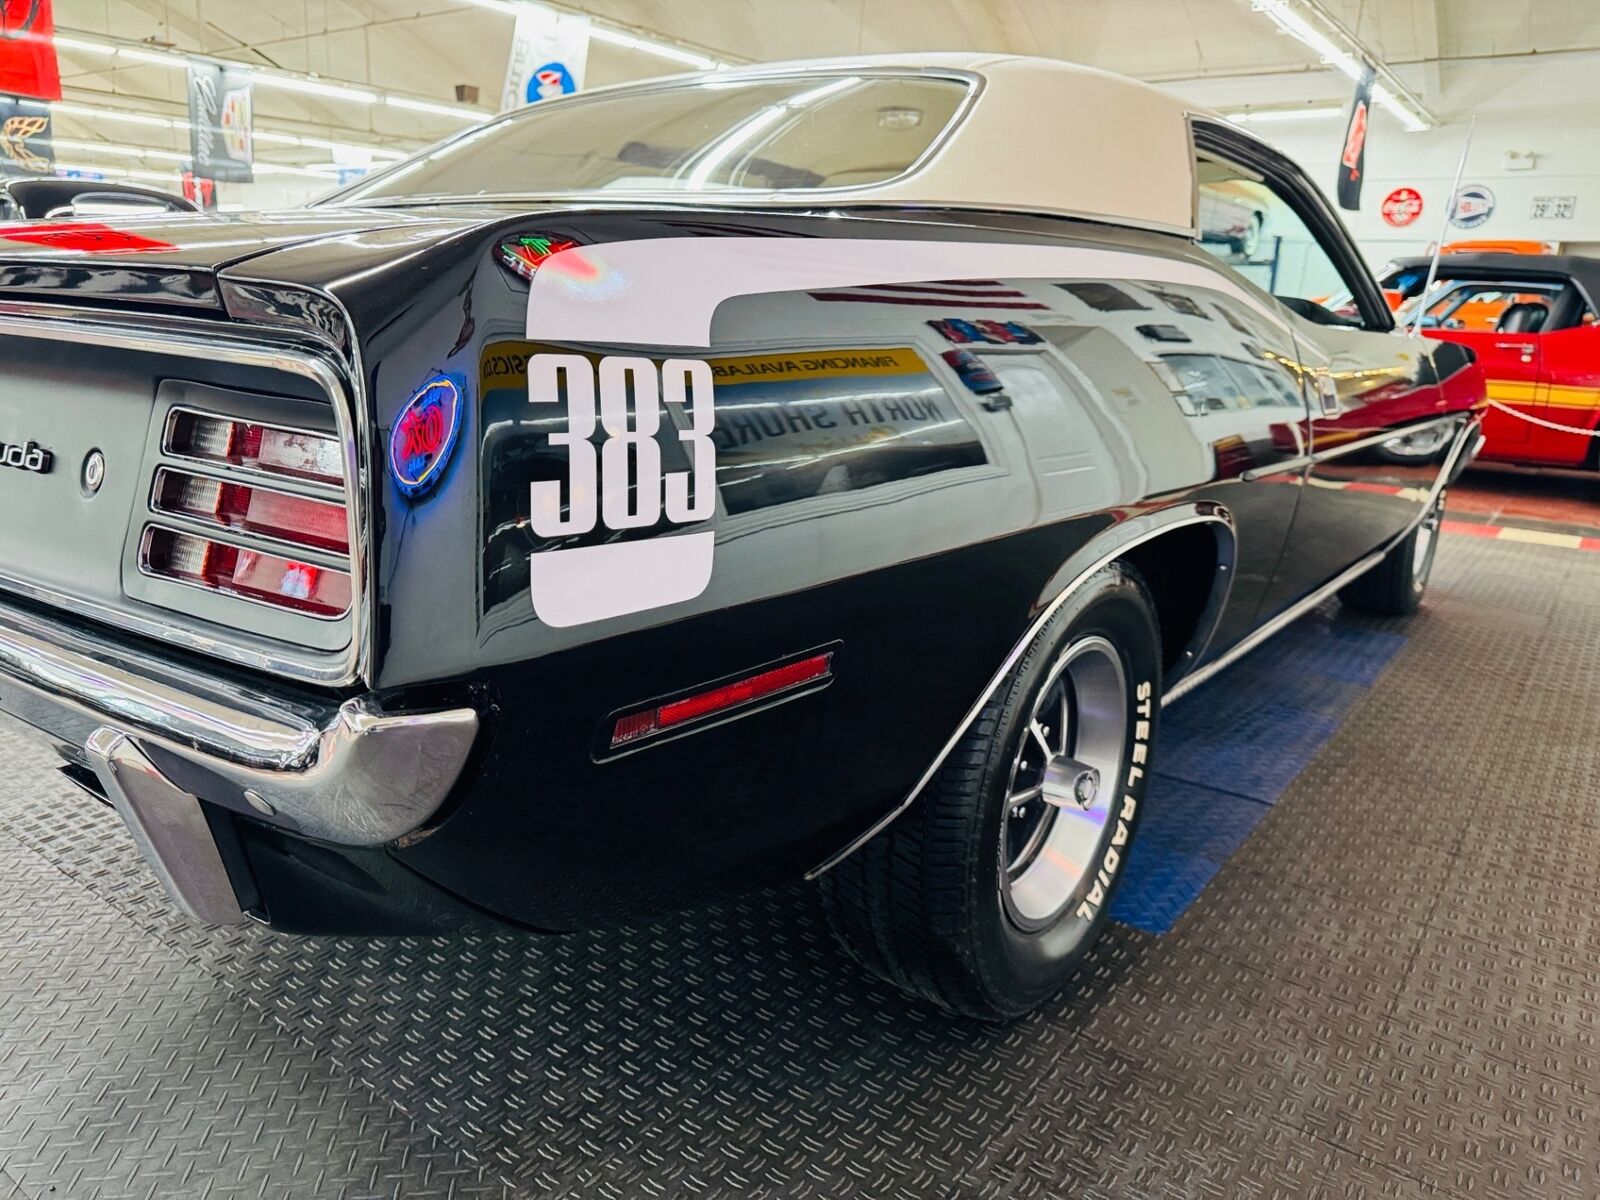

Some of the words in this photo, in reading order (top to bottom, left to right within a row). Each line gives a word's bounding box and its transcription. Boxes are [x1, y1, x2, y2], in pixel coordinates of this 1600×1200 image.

[527, 353, 716, 538] 383
[1127, 681, 1151, 788] STEEL
[1076, 794, 1137, 921] RADIAL
